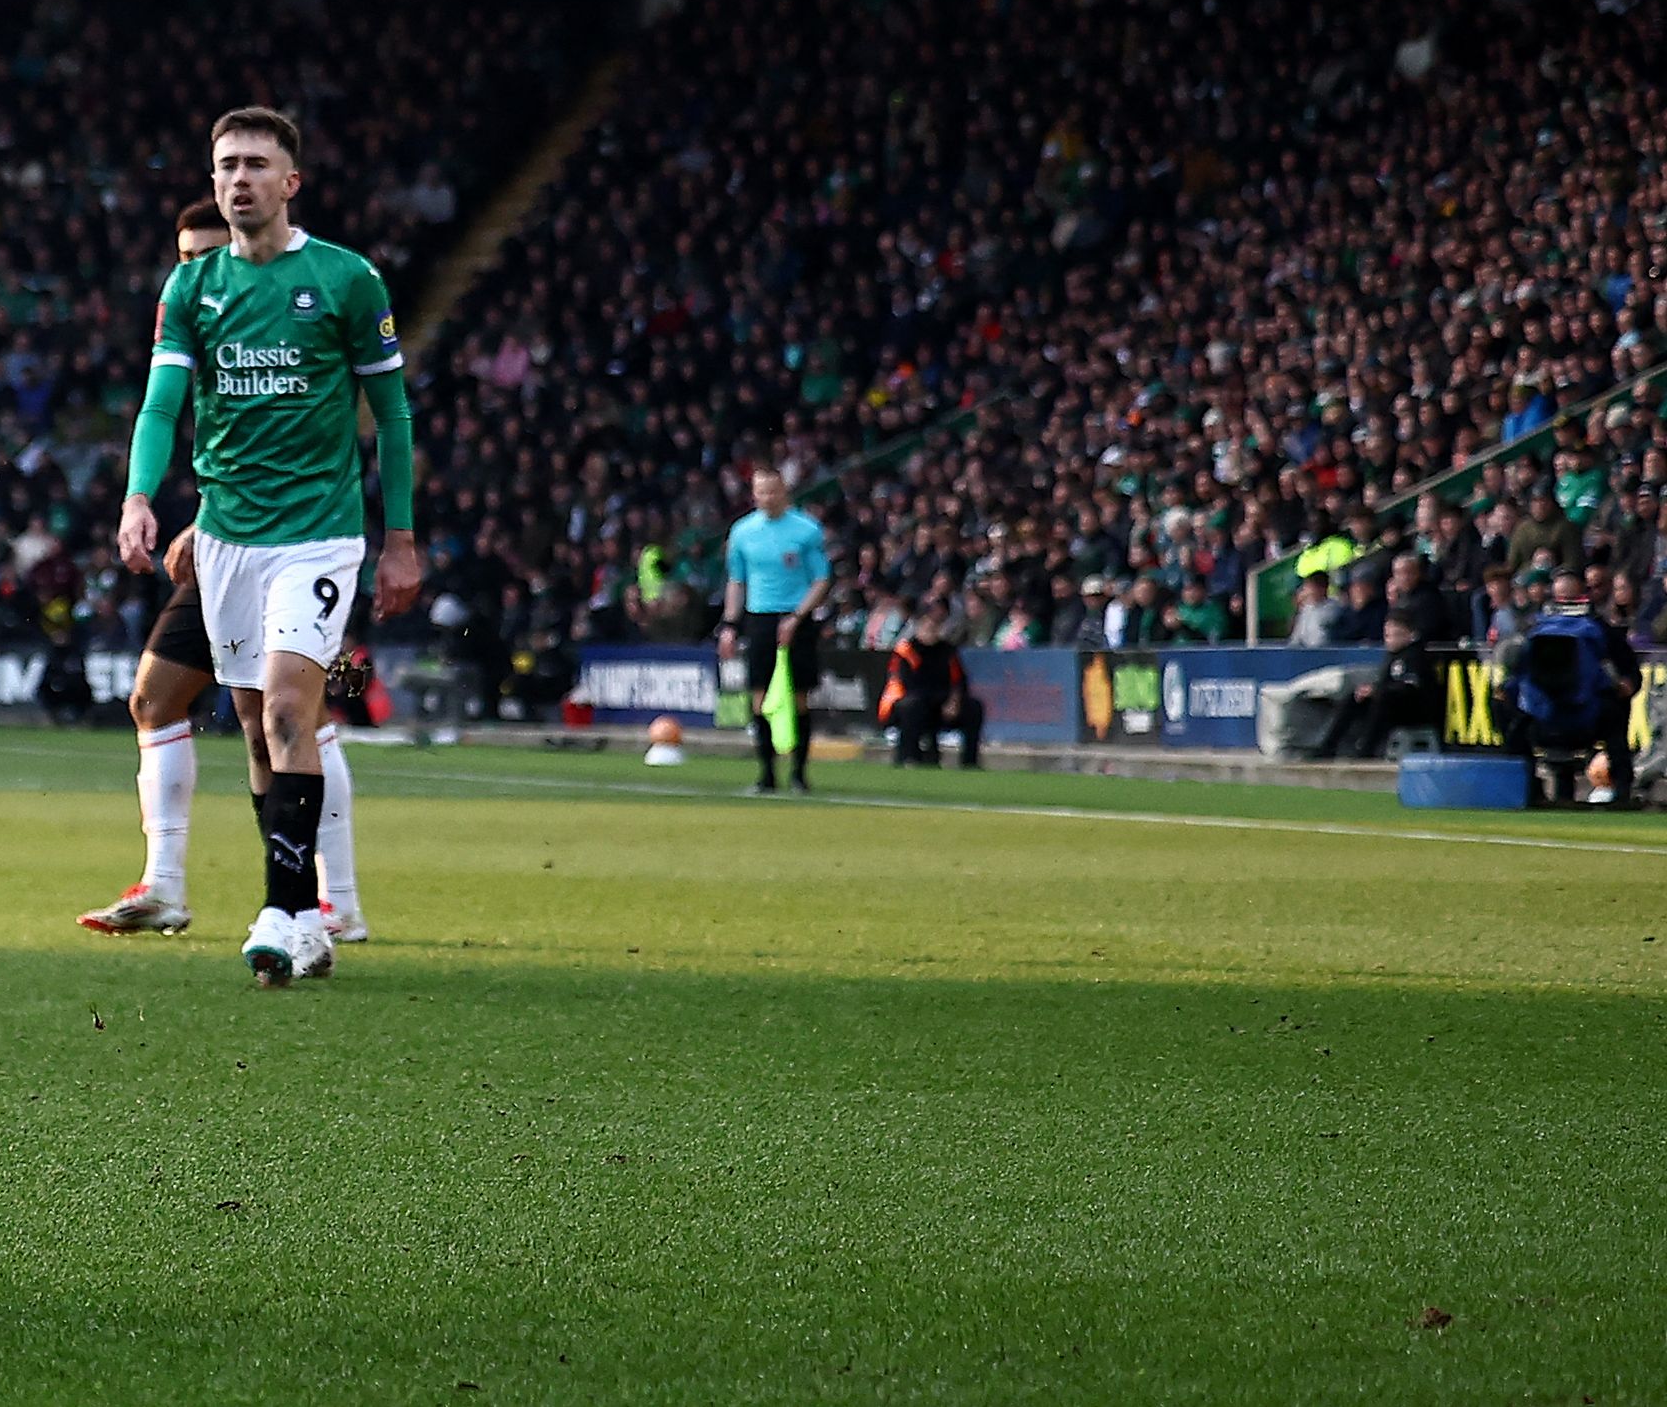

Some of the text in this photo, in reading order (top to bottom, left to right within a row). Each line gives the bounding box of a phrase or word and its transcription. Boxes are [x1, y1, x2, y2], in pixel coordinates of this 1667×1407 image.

[216, 339, 301, 369] Classic
[215, 369, 309, 396] Builders
[312, 576, 341, 621] 9
